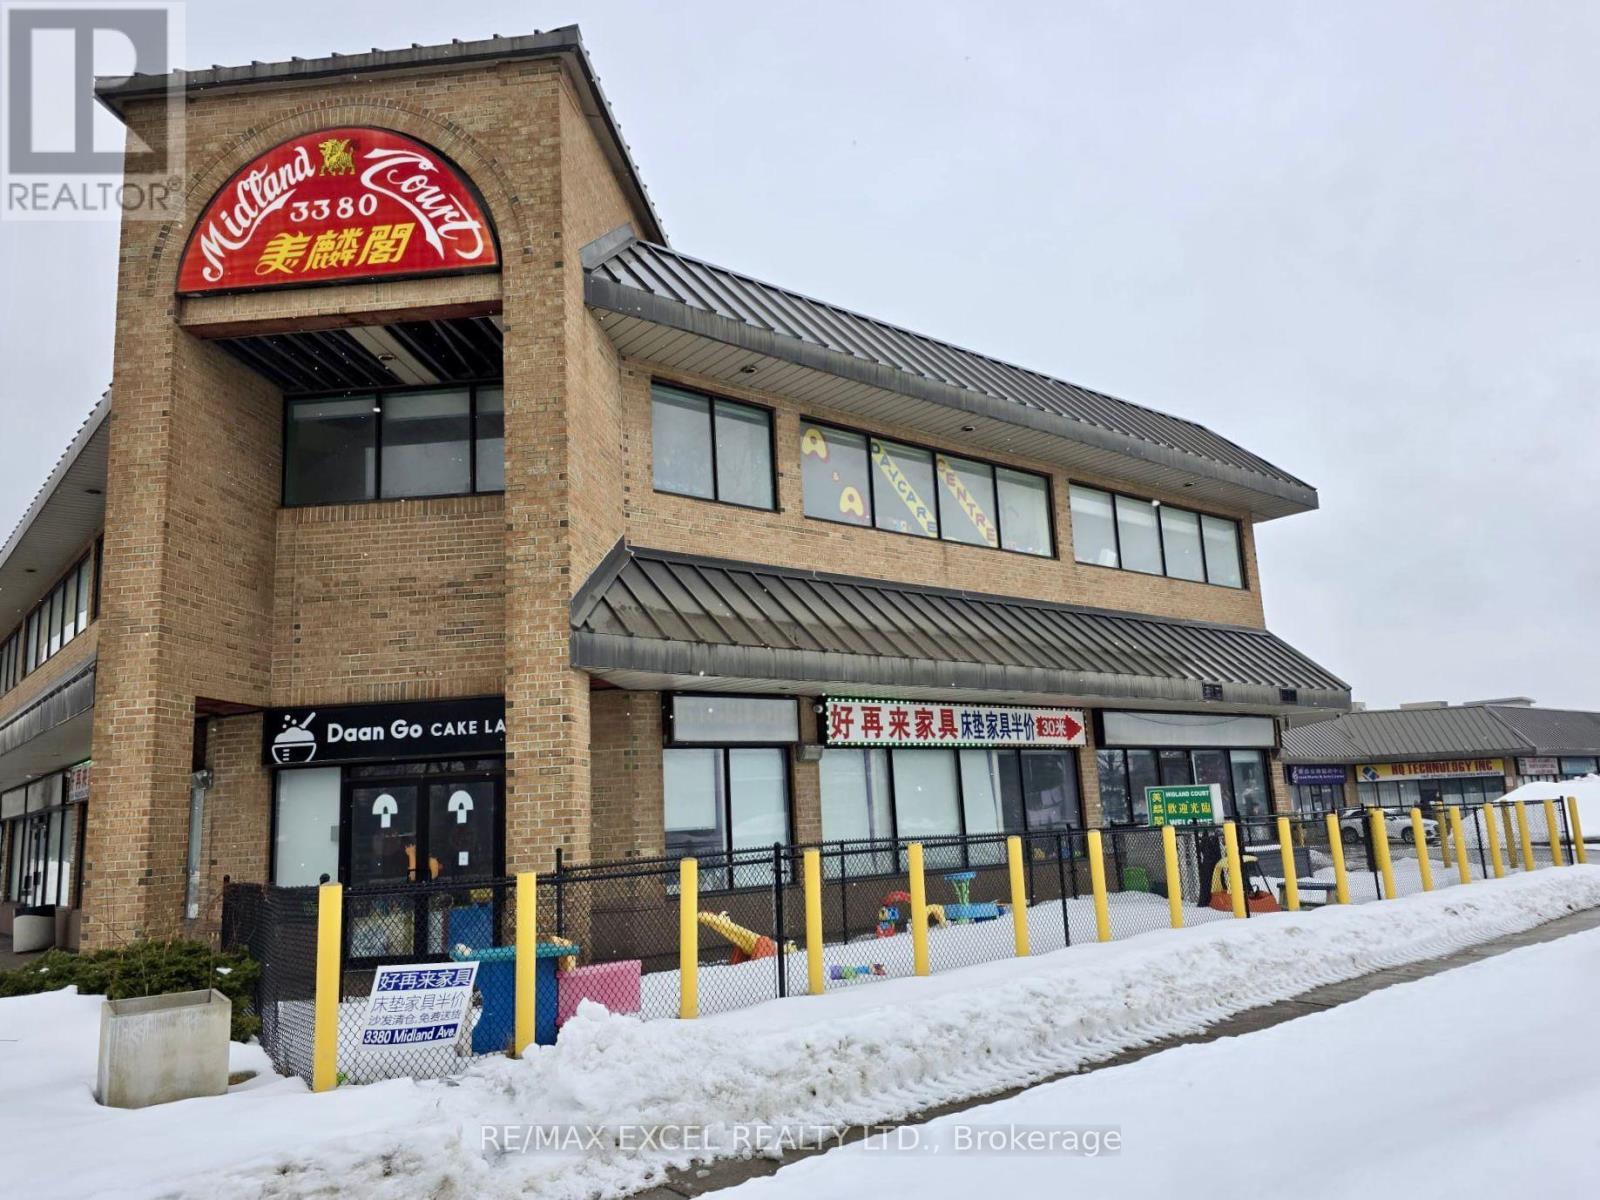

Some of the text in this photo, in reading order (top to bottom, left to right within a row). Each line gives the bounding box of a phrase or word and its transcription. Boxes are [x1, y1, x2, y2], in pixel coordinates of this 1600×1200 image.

[200, 146, 483, 282] Midland Court
[290, 193, 378, 222] 3380
[255, 222, 415, 276] 美麟閣
[802, 428, 828, 461] A
[840, 486, 868, 519] A
[871, 442, 937, 533] DAYCARE
[937, 458, 996, 541] CENTRE
[327, 722, 384, 743] Daan
[391, 719, 423, 740] Go
[431, 720, 478, 737] CAKE
[830, 704, 958, 741] 好再来家具
[961, 710, 1035, 741] 床垫家具半价
[1408, 760, 1473, 774] TECHNOLOGY
[1475, 759, 1493, 771] INC
[379, 969, 471, 990] 好再来家具
[370, 991, 465, 1013] 床垫家具半价
[364, 1030, 391, 1043] 3380
[393, 1027, 433, 1043] Midland
